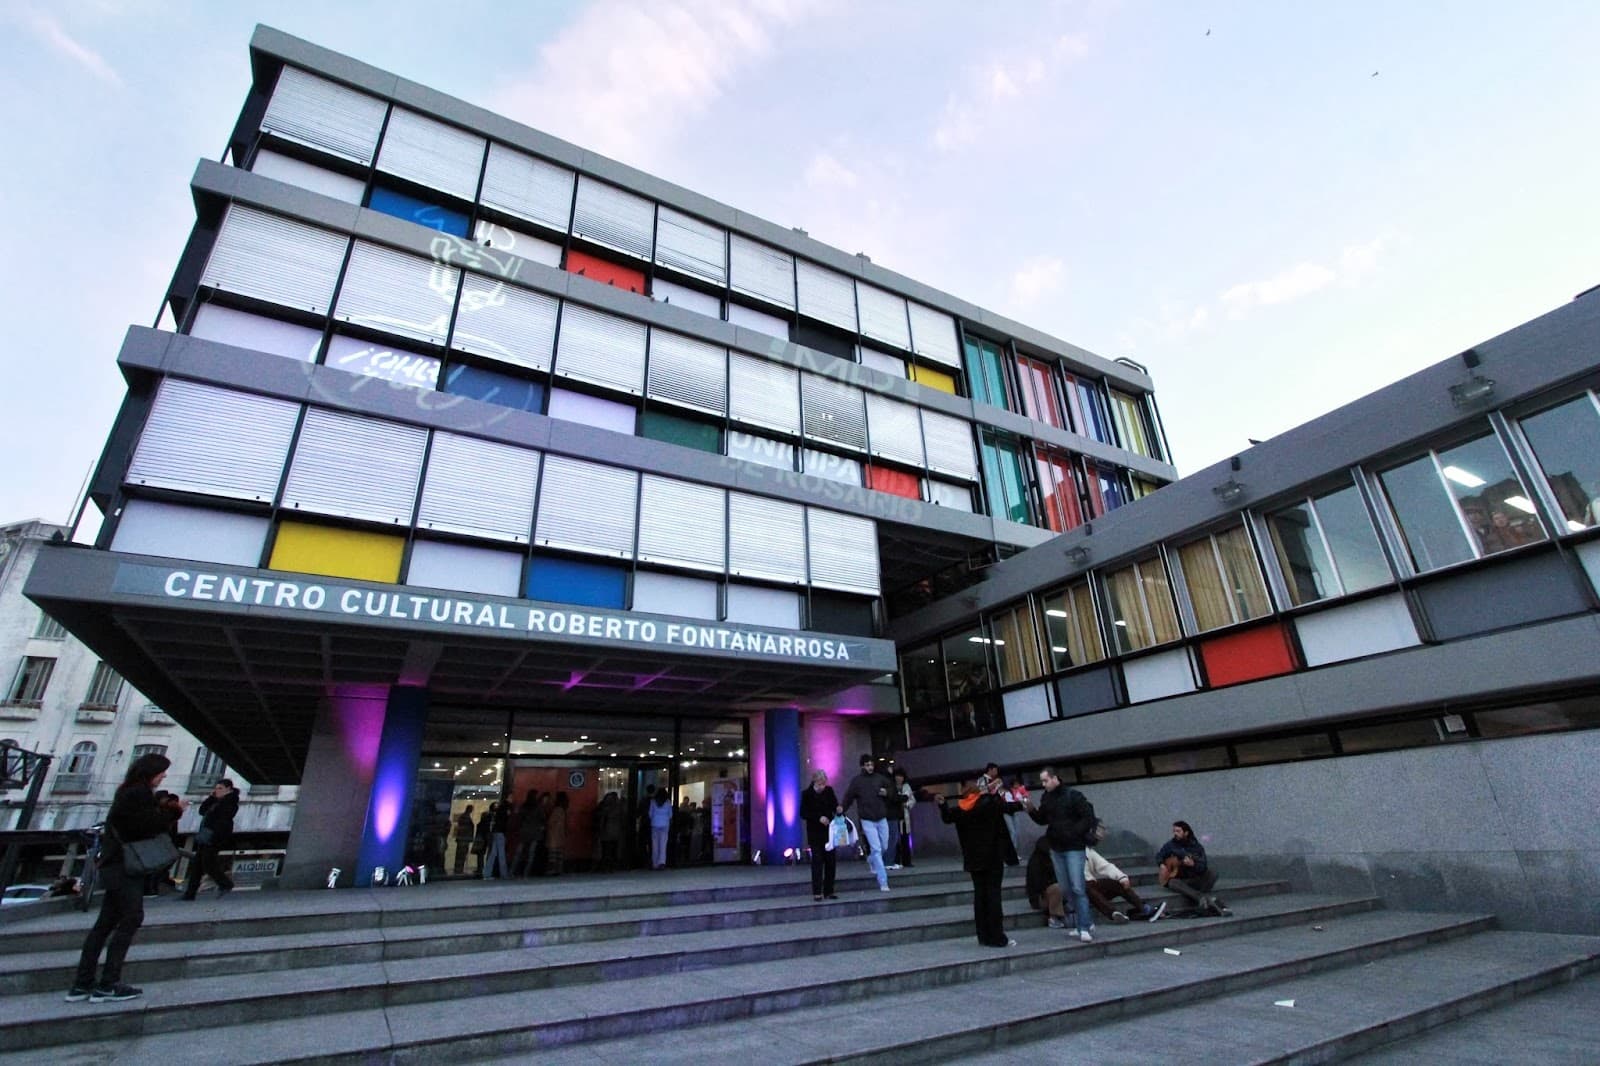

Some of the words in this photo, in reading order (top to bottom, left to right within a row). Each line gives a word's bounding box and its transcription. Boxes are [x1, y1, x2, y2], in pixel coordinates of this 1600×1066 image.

[164, 571, 326, 610] CENTRO
[340, 590, 515, 629] CULTURAL
[528, 609, 657, 642] ROBERTO
[666, 624, 850, 660] FONTANARROSA
[236, 862, 275, 872] ALQUILO
